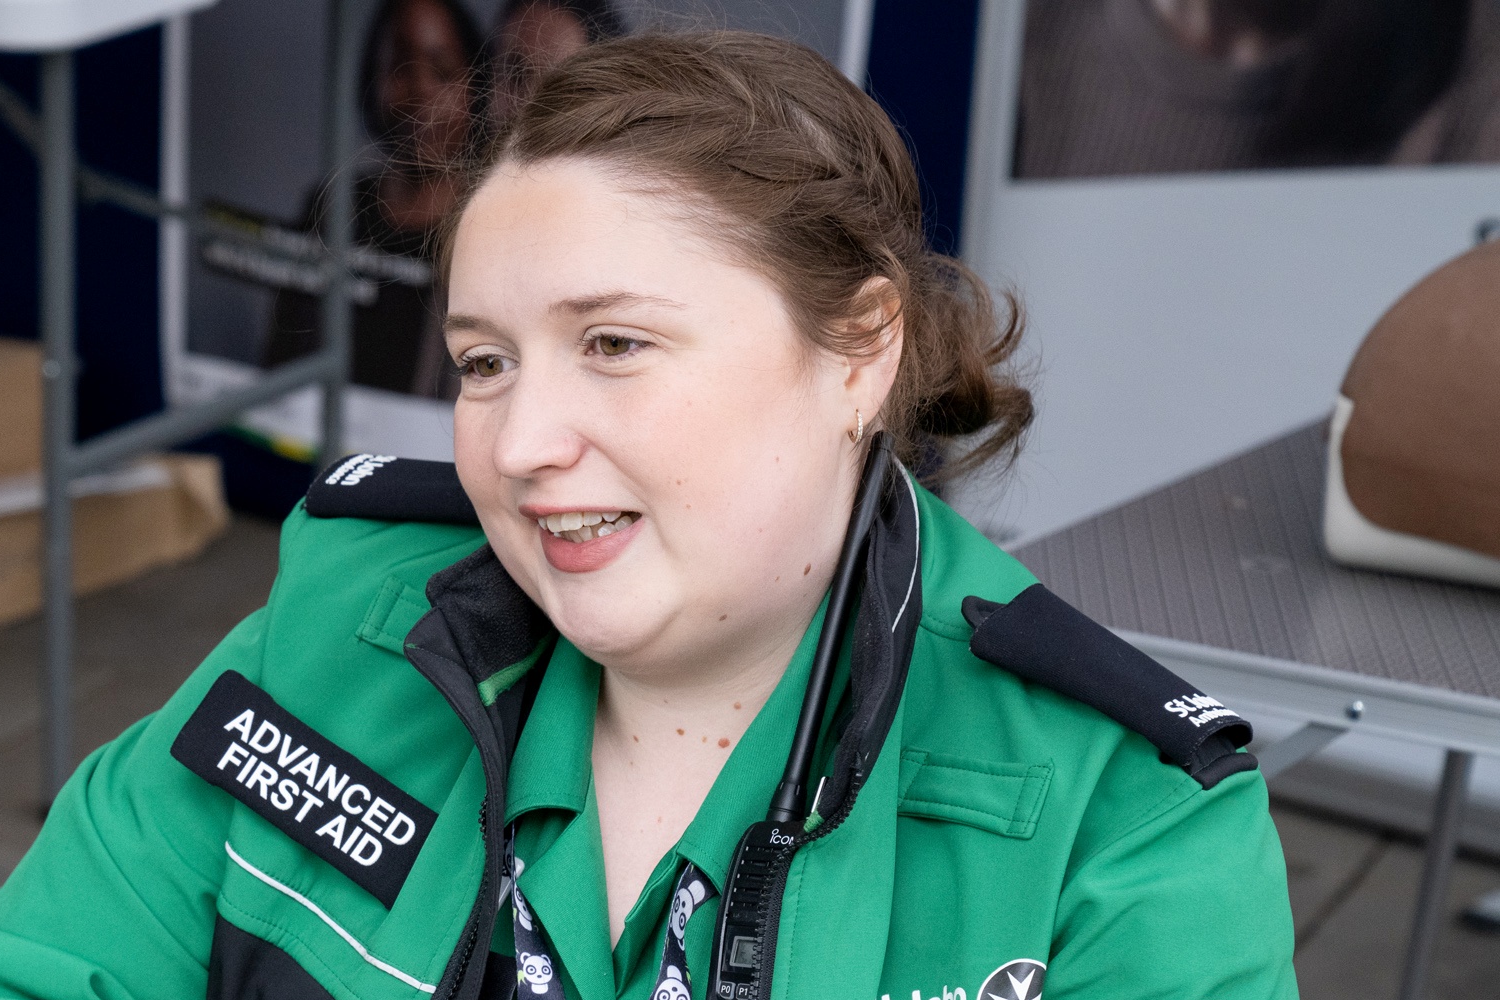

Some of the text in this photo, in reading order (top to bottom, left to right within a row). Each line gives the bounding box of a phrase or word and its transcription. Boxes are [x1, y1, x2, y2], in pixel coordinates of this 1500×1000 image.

[217, 742, 383, 867] FIRST AID
[223, 708, 416, 845] ADVANCED
